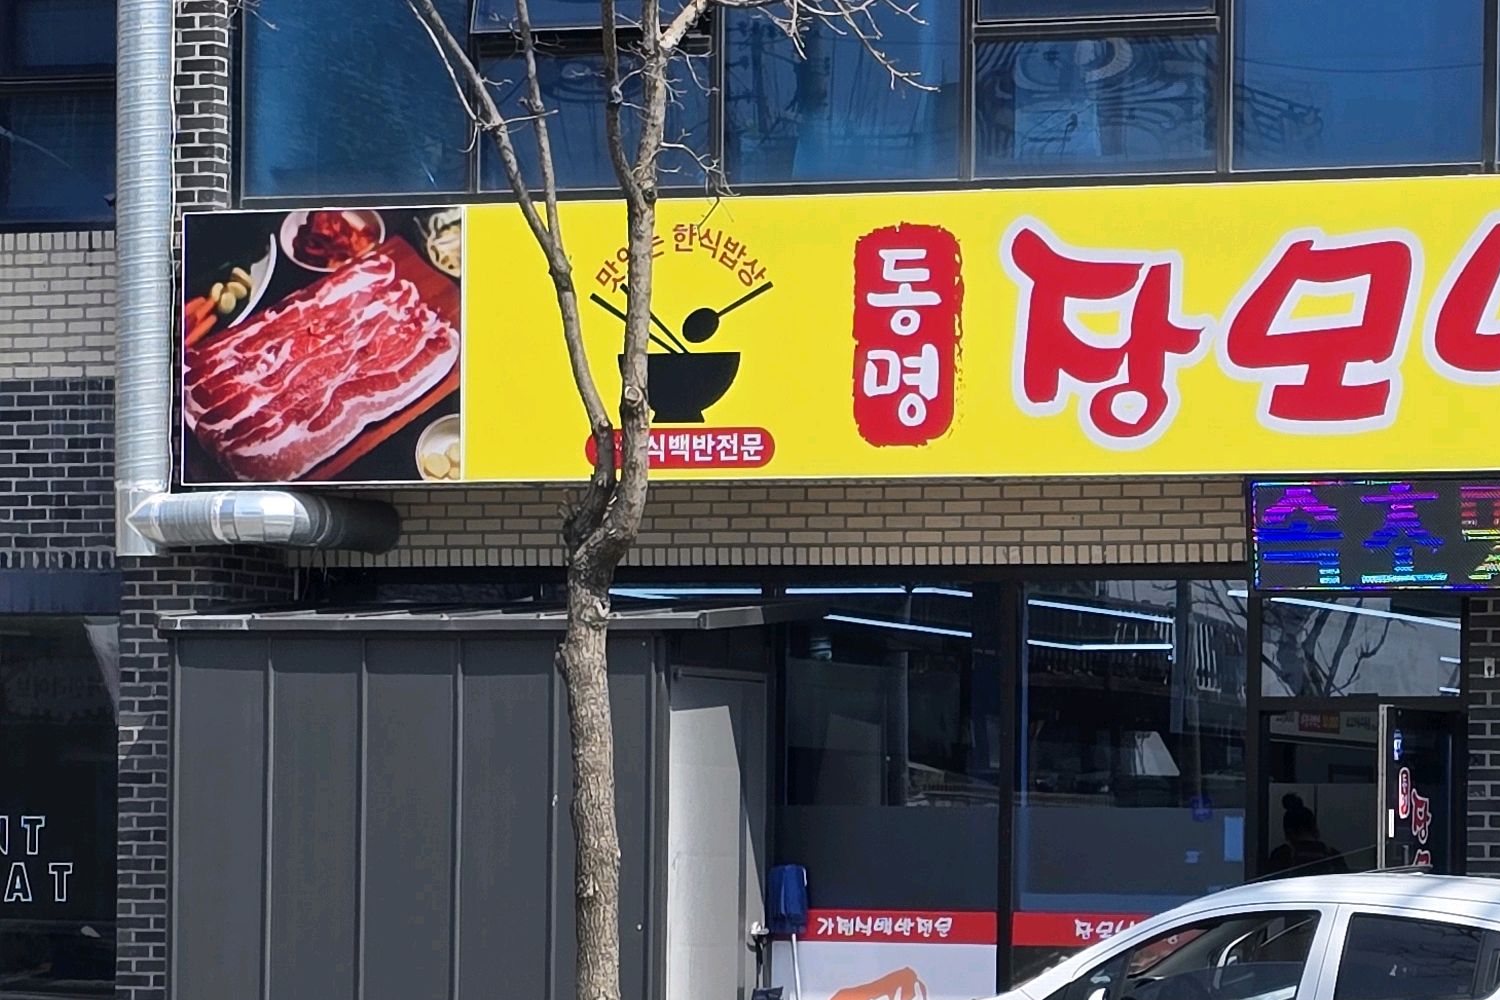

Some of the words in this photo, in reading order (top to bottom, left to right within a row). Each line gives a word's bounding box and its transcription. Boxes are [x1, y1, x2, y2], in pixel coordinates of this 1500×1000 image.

[672, 223, 768, 287] 한식밥상
[862, 248, 943, 427] 동명
[817, 915, 953, 938] 가정식백반전문
